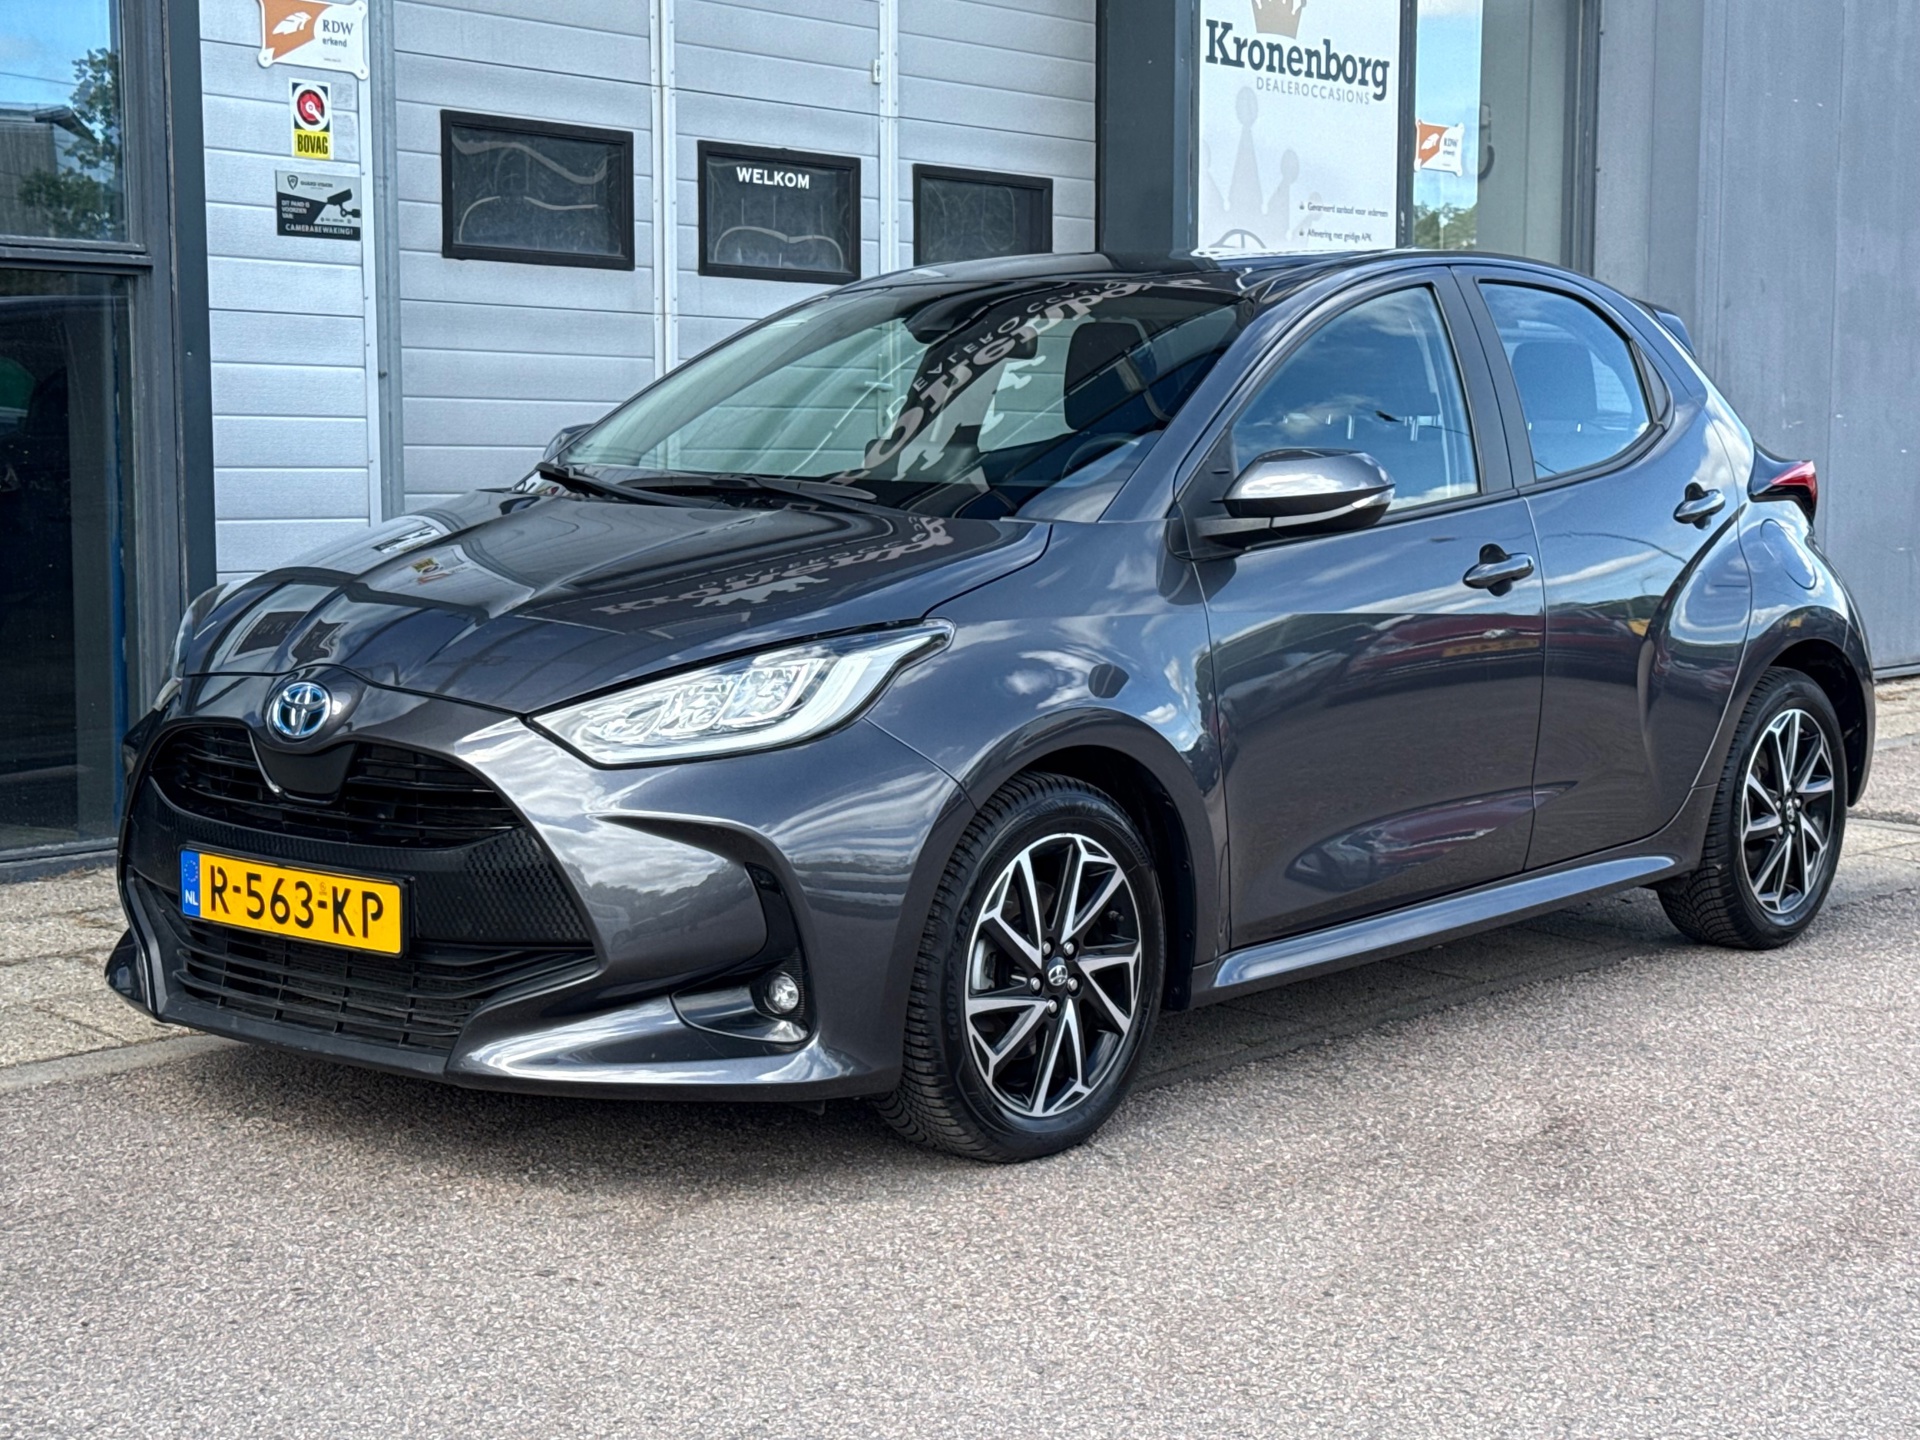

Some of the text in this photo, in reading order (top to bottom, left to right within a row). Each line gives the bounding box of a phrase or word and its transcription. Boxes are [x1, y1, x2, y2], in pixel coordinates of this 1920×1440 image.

[322, 18, 354, 36] RDW
[322, 37, 347, 48] erkend
[1205, 18, 1390, 101] Kronenborg
[1256, 76, 1370, 105] DEALEROCCASIONS
[297, 133, 328, 155] BOVAG
[736, 166, 810, 189] WELKOM
[285, 223, 353, 235] CAMERABEWAKING!
[184, 889, 199, 906] NL
[210, 864, 384, 939] R-563-KP
